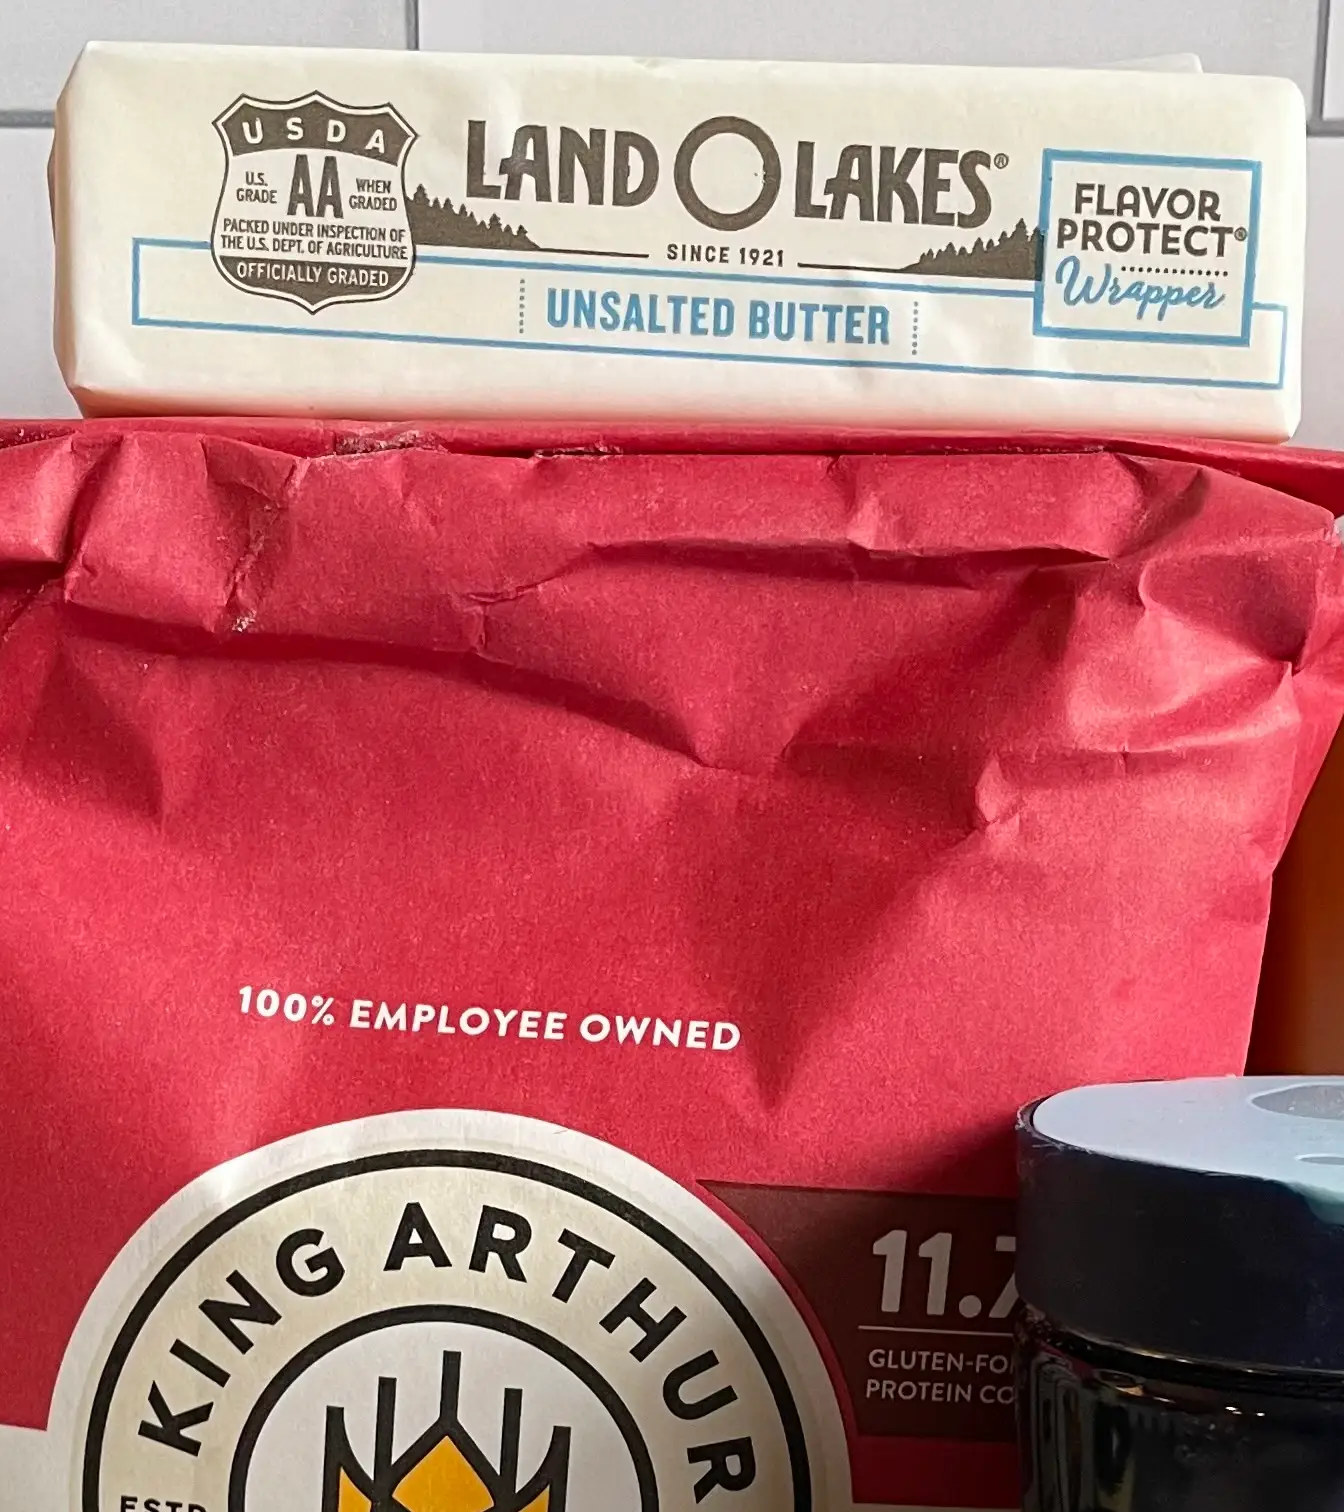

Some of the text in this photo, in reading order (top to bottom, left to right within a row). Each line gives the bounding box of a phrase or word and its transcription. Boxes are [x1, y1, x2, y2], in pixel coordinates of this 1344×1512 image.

[242, 117, 385, 154] USDA
[245, 171, 268, 187] U.S.
[287, 154, 344, 219] AA
[356, 178, 392, 194] WHEN
[466, 119, 659, 207] LAND
[674, 116, 782, 231] O
[236, 189, 277, 204] GRADE
[349, 195, 397, 211] GRADED
[1074, 182, 1221, 221] FLAVOR
[223, 218, 405, 242] PACKED UNDER INSPECTION OF
[221, 234, 408, 260] THE U.S. DEPT. OF AGRICULTURE
[666, 244, 785, 268] SINCE 1921
[236, 262, 389, 287] OFFICIALLY GRADED
[1055, 255, 1226, 321] Wrapper
[547, 287, 890, 346] UNSALTED BUTTER
[239, 985, 742, 1051] 100% EMPLOYEE OWNED
[137, 1201, 756, 1504] KING ARTHUR
[868, 1349, 1014, 1375] GLUTEN-FO
[865, 1378, 972, 1403] PROTEIN
